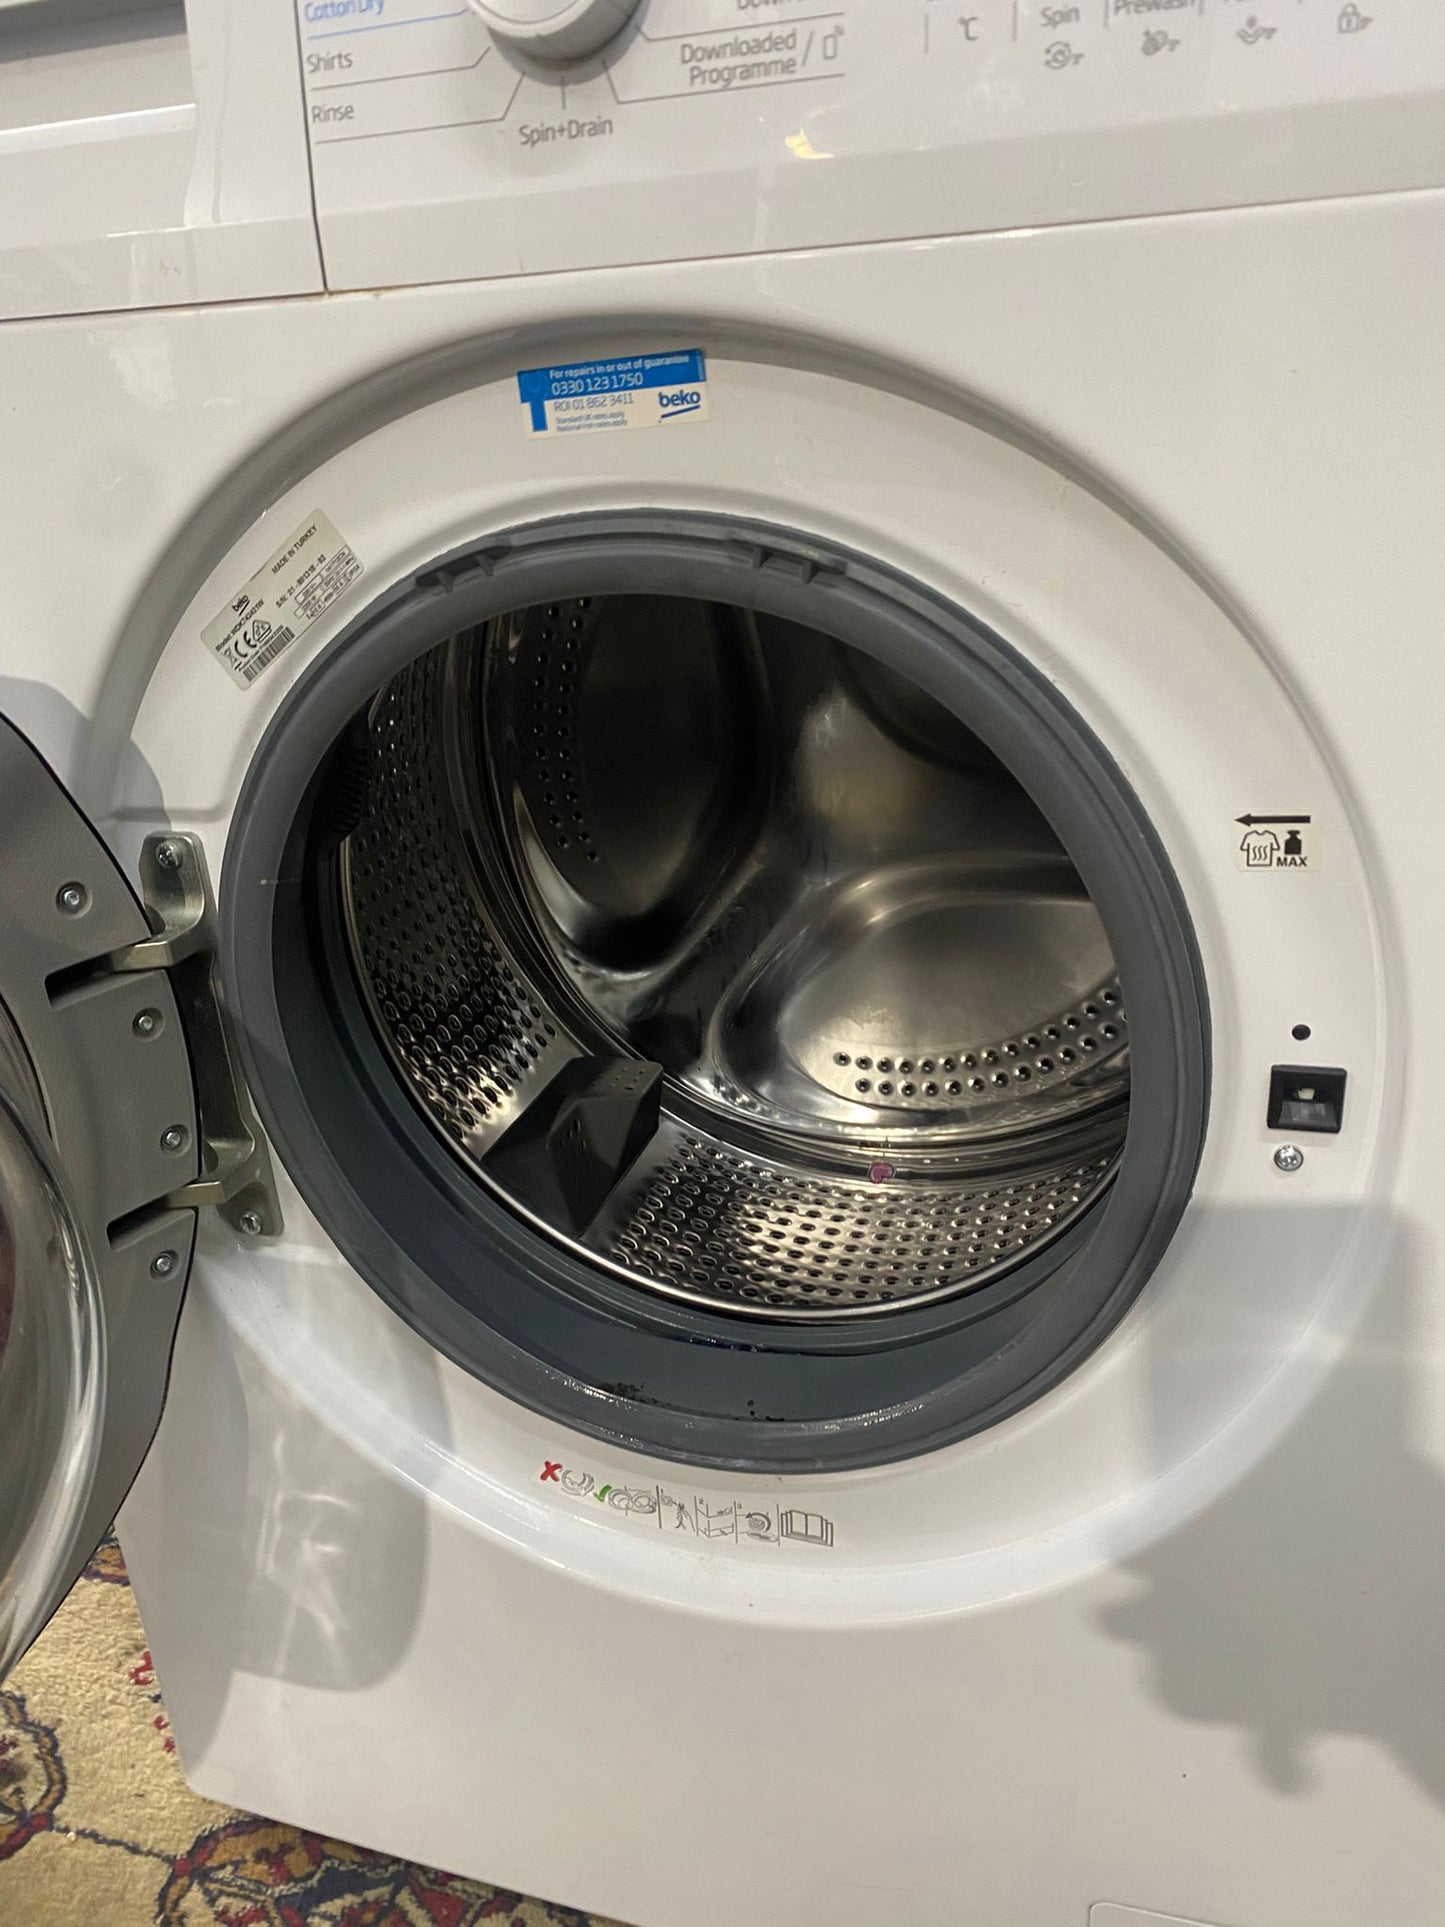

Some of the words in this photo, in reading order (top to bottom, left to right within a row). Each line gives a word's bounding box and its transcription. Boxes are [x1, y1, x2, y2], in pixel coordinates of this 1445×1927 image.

[305, 0, 356, 22] Cotton
[1041, 5, 1080, 28] Spin
[680, 28, 797, 64] Downloaded
[306, 51, 353, 73] Shirts
[689, 57, 797, 88] Programme
[311, 102, 354, 124] Rinse
[518, 115, 613, 148] Spin+Drain
[549, 370, 564, 380] For
[565, 366, 595, 378] repairs
[616, 361, 632, 371] out
[633, 359, 643, 369] of
[644, 355, 690, 370] guarantee
[551, 379, 584, 396] 0330
[586, 376, 610, 392] 123
[611, 372, 643, 390] 1750
[658, 389, 701, 408] beko
[271, 555, 289, 574] MADE
[293, 524, 317, 549] TURKEY
[232, 594, 249, 612] beko
[1276, 856, 1308, 868] MAX
